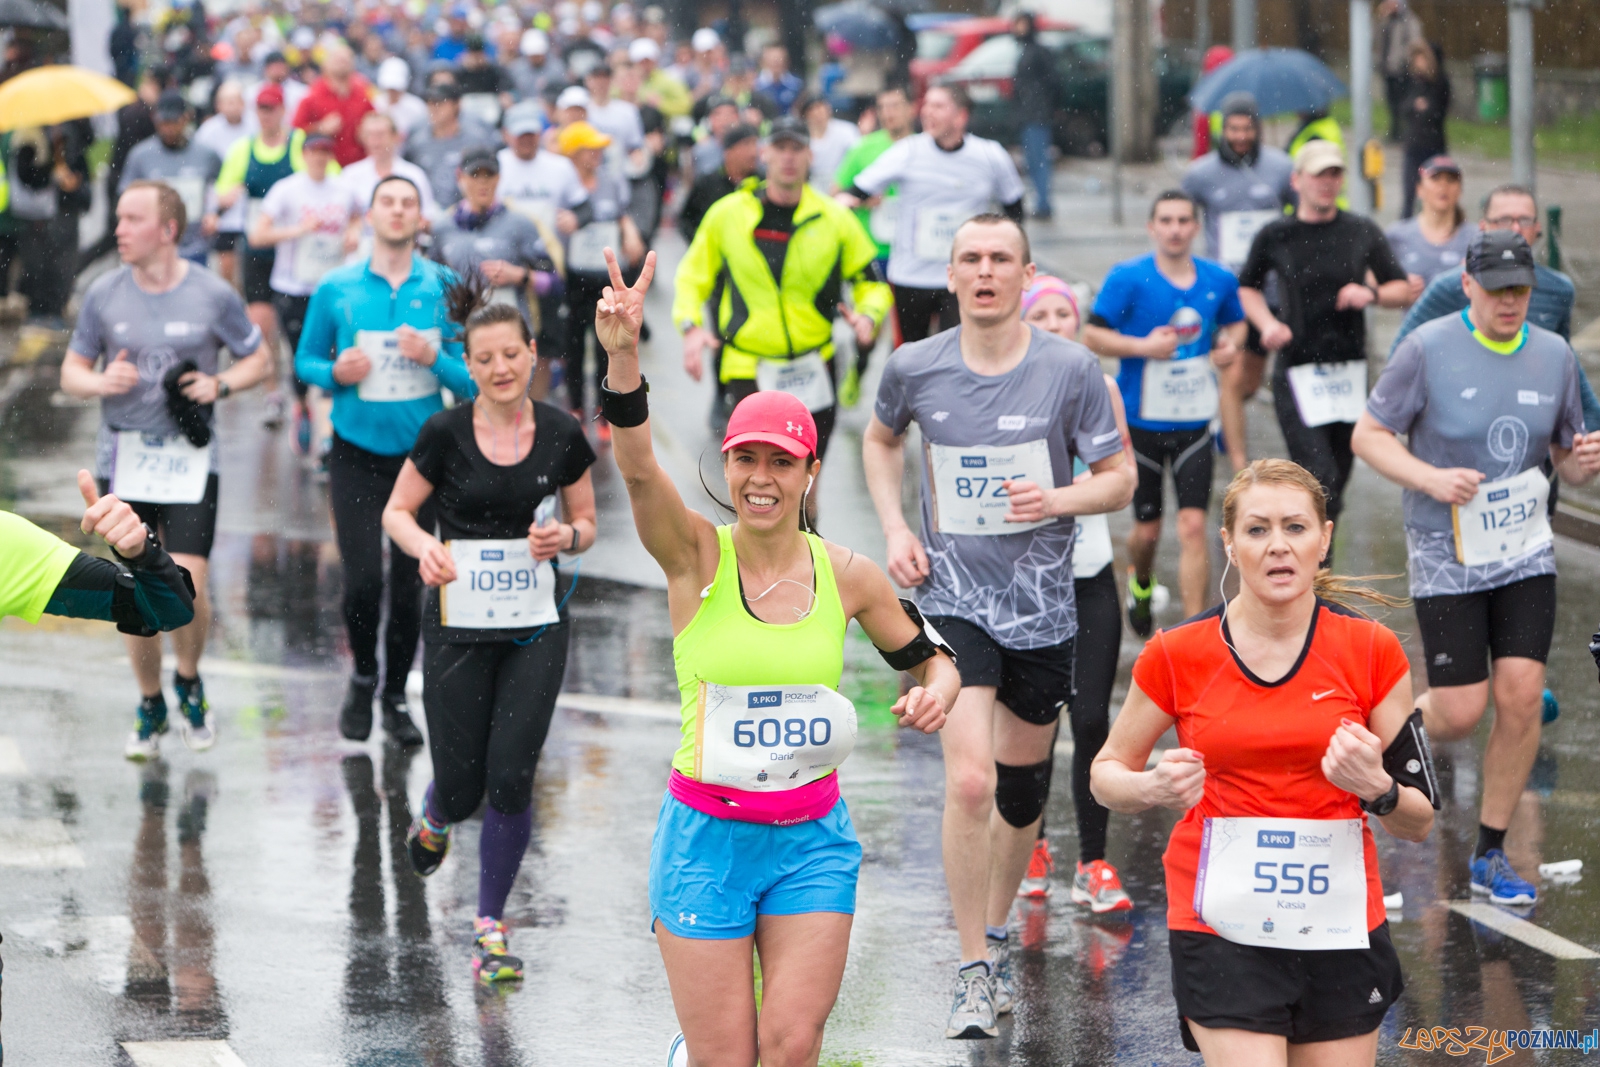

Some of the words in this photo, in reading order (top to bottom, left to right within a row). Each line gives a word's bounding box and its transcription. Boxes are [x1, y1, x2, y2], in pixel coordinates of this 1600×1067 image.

[1487, 415, 1529, 482] 9
[134, 452, 189, 475] 7236
[956, 474, 1026, 498] 872
[1480, 498, 1538, 531] 11232
[469, 569, 537, 591] 10991
[752, 696, 759, 704] 9.
[760, 695, 777, 704] PKO
[733, 717, 832, 748] 6080
[770, 752, 794, 761] Daria
[772, 814, 810, 826] Activbelt
[1270, 834, 1290, 845] PKO
[1253, 861, 1330, 895] 556
[1276, 900, 1306, 910] Kasia
